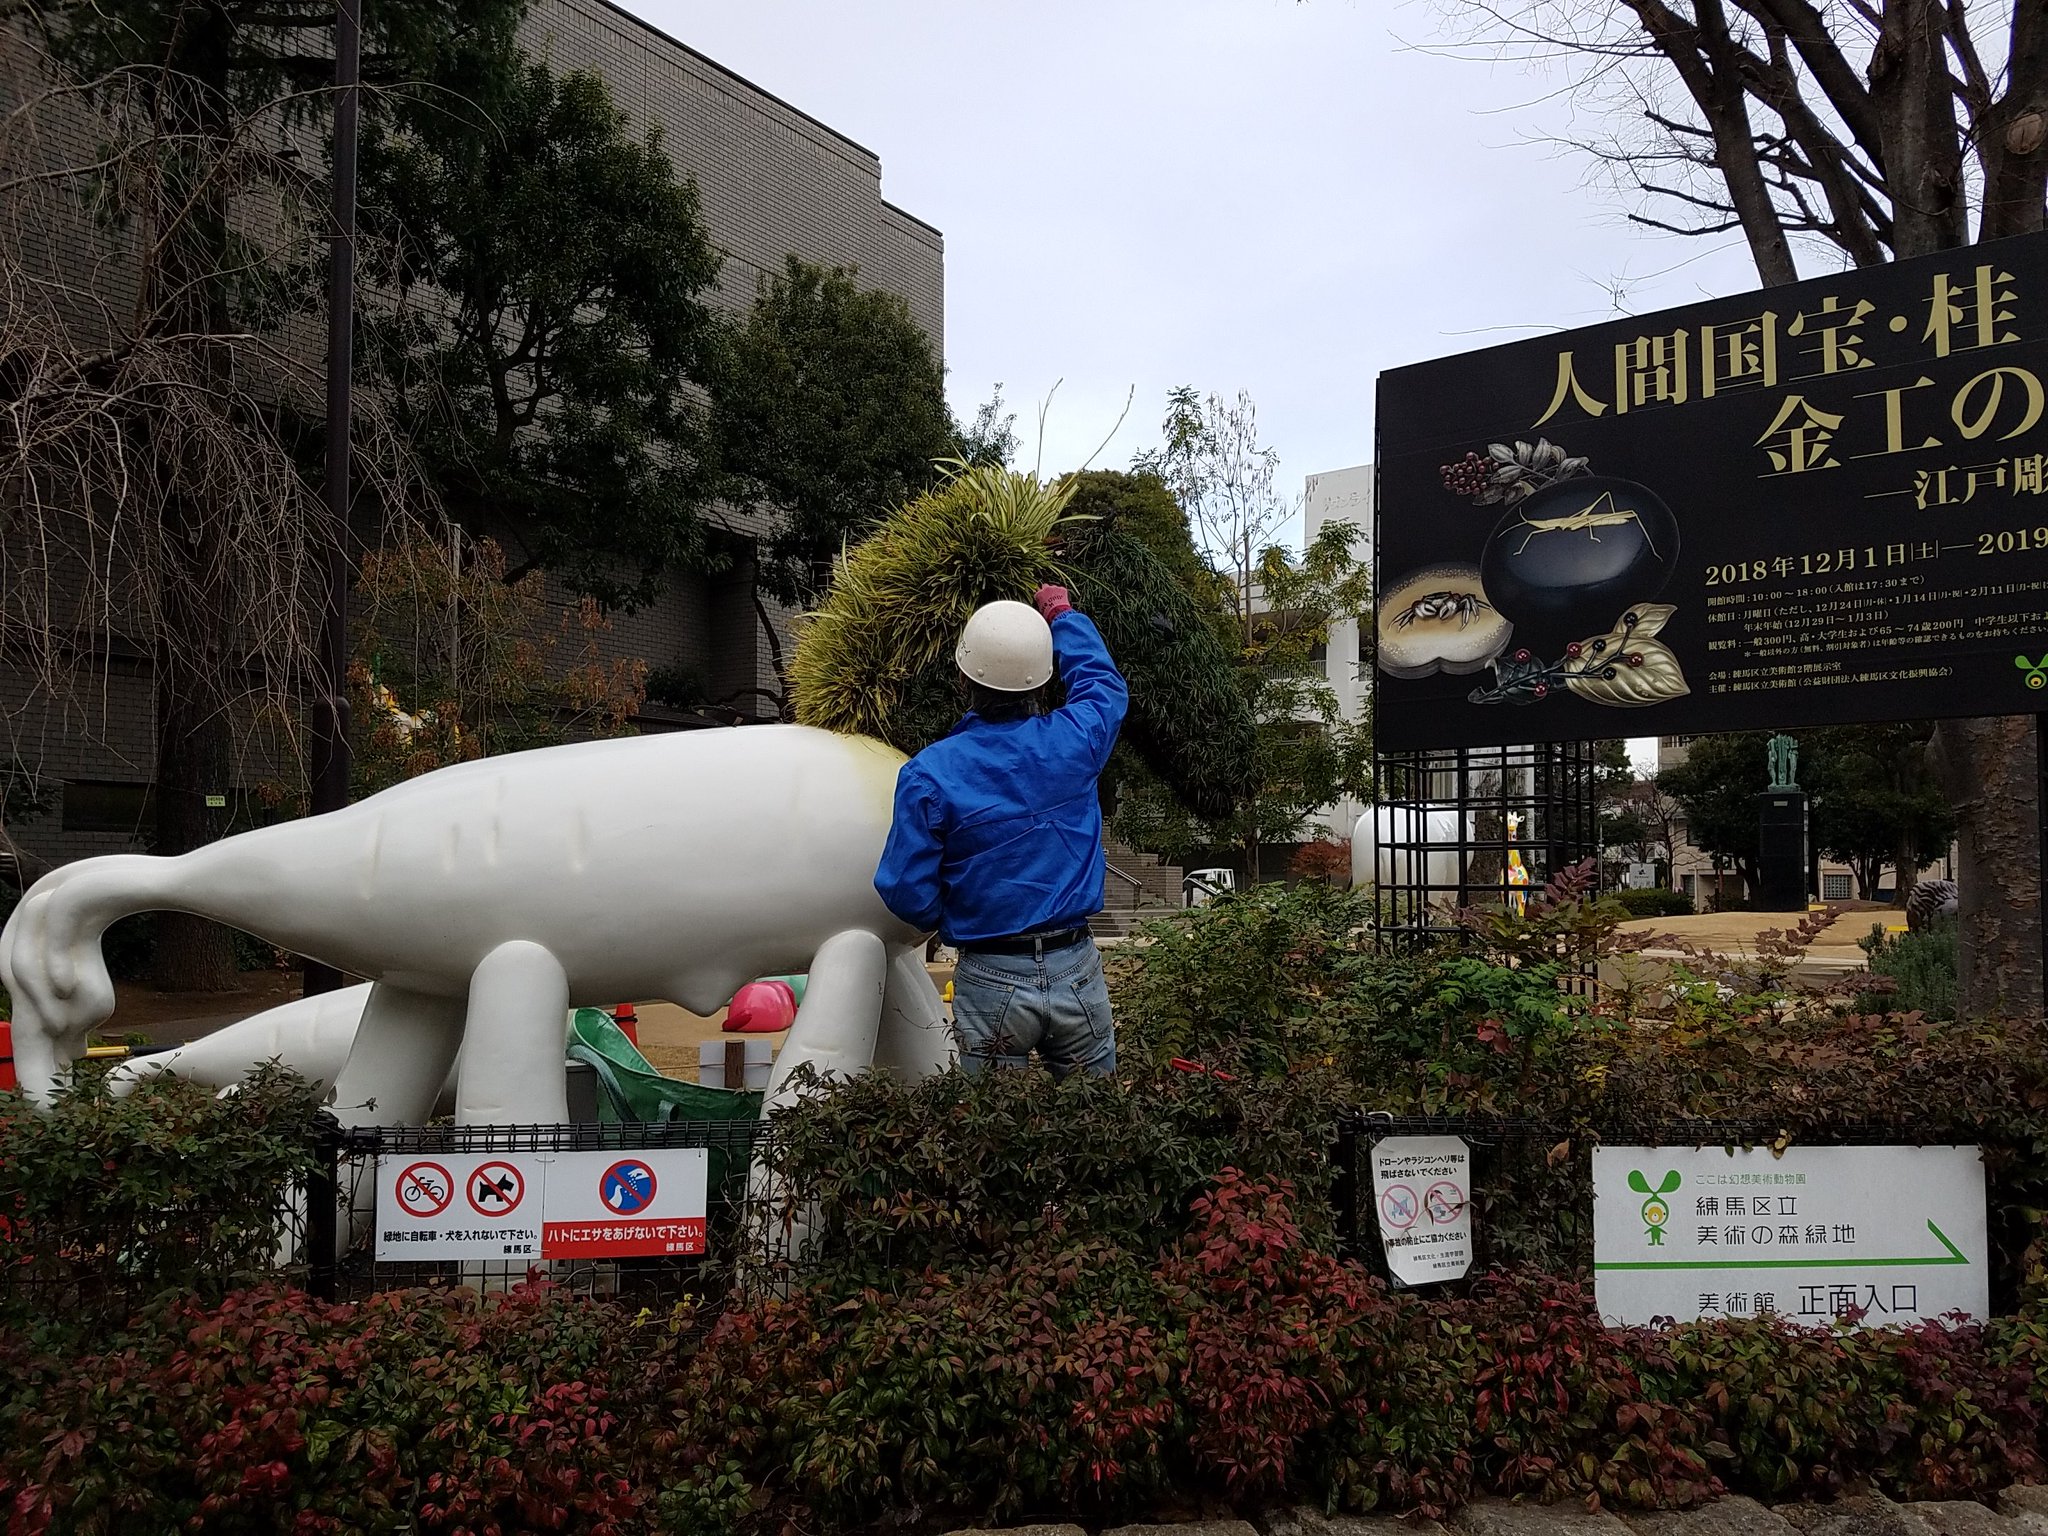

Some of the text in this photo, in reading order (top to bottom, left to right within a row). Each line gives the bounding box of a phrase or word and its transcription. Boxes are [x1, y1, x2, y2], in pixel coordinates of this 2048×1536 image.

[1530, 264, 2022, 430] 人間国宝・桂
[1754, 366, 2045, 478] 金工の
[1379, 1154, 1465, 1167] ドローンやラジコンヘリ等は
[1381, 1167, 1457, 1179] 飛ばさないでください
[1696, 1173, 1806, 1186] ここは幻想美術動物園
[1695, 1196, 1798, 1216] 練馬区立
[383, 1229, 538, 1243] 緑地に自転車・犬を入れないで下さい。
[548, 1226, 704, 1243] ハトにエサをあげないで下さい。
[1697, 1224, 1855, 1245] 美術の森緑地
[503, 1244, 532, 1254] 練馬区
[665, 1242, 694, 1252] 練馬区
[1698, 1292, 1775, 1313] 美術館
[1797, 1284, 1917, 1316] 正面入口
